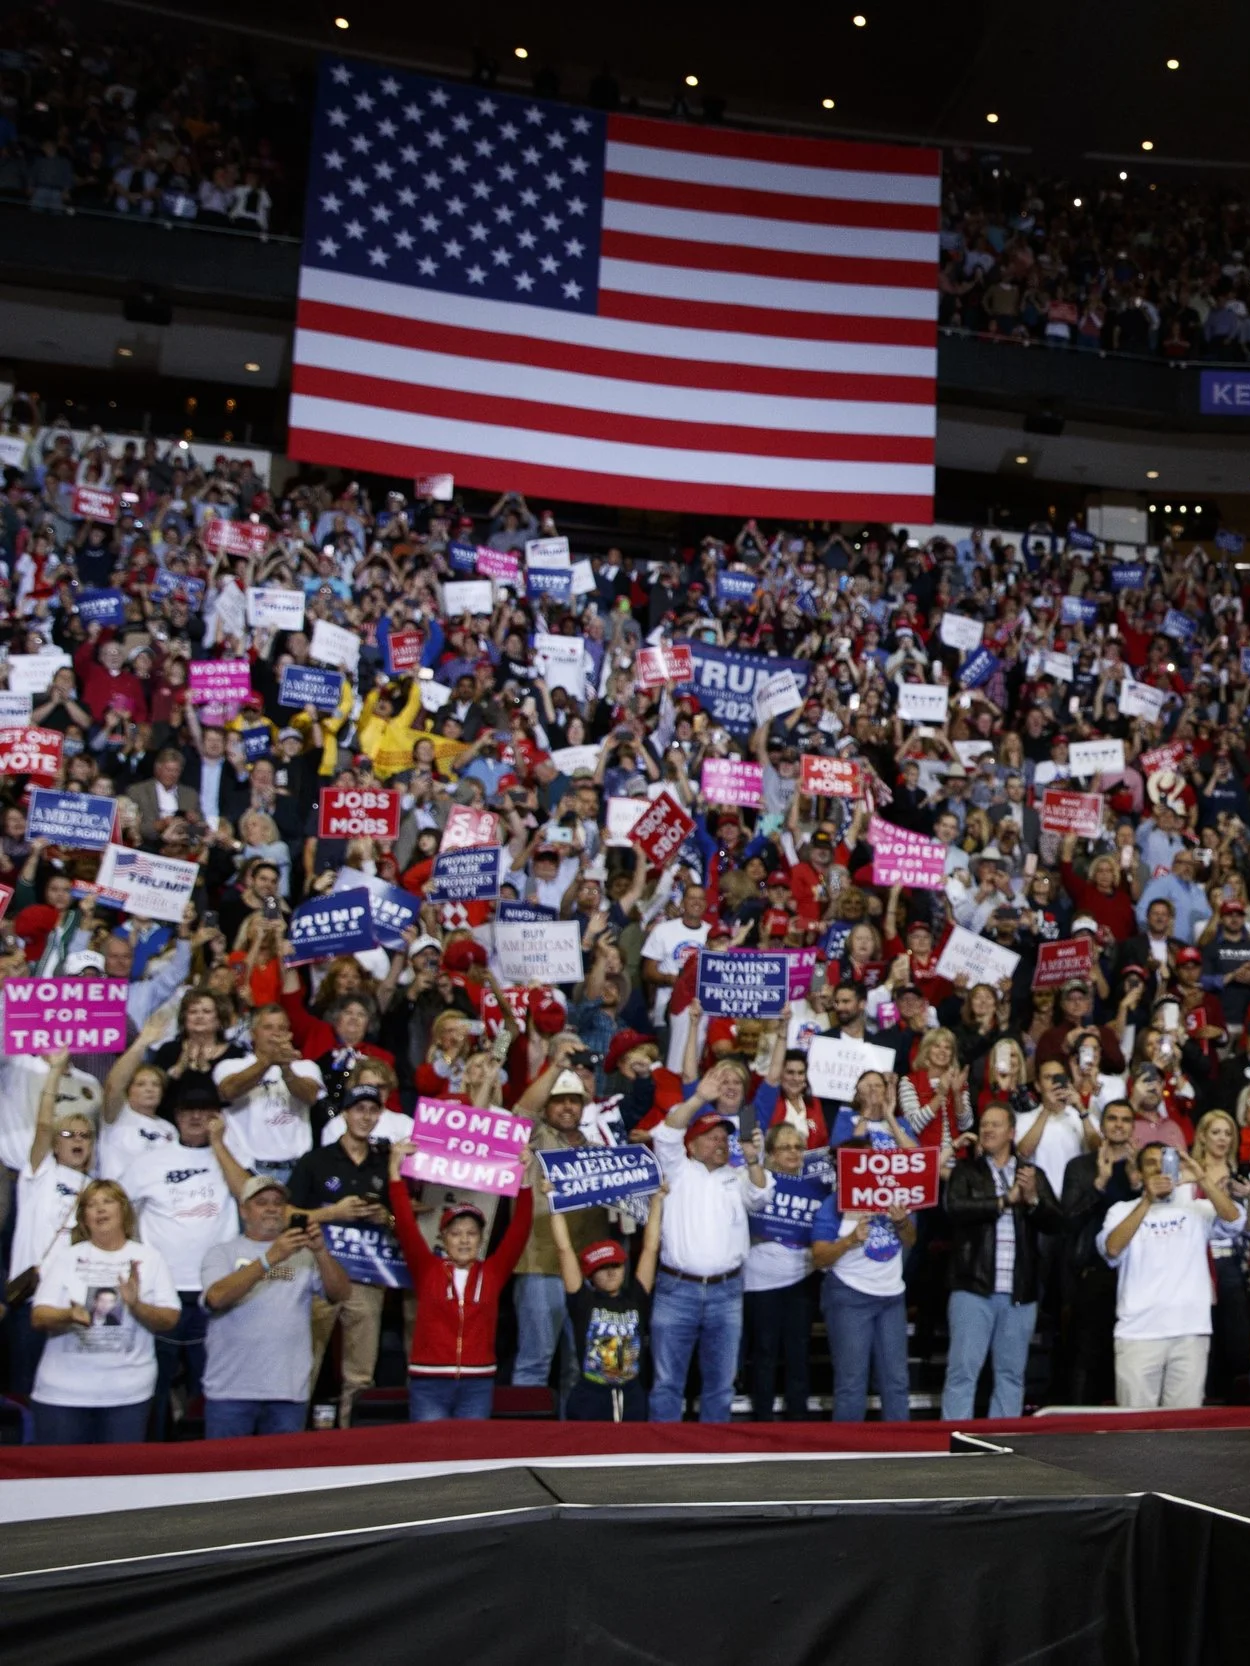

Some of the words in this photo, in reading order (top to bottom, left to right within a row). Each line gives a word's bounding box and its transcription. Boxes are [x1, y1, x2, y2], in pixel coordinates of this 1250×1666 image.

[529, 573, 570, 585] TRUMP
[190, 662, 250, 676] WOMEN
[713, 699, 757, 722] 202
[26, 730, 61, 747] OUT
[0, 752, 57, 772] VOTE
[704, 762, 763, 778] WOMEN
[809, 759, 853, 775] JOBS
[808, 778, 854, 793] MOBS
[332, 790, 390, 809] JOBS
[704, 787, 761, 802] TRUMP
[34, 807, 111, 830] AMERICA
[330, 817, 388, 834] MOBS
[635, 799, 672, 840] MOBS
[30, 823, 73, 839] STRONG
[75, 827, 110, 841] AGAIN
[652, 818, 686, 859] JOBS
[438, 852, 494, 867] PROMISES
[876, 843, 946, 860] WOMEN
[896, 858, 923, 868] FOR
[128, 872, 191, 893] TRUMP
[435, 875, 493, 888] PROMISES
[879, 868, 942, 885] TRUMP
[369, 895, 413, 919] UMP
[522, 929, 546, 938] BUY
[502, 939, 575, 952] AMERICAN
[706, 958, 781, 975] PROMISES
[1041, 956, 1092, 971] AMERICA
[720, 972, 766, 987] MADE
[6, 982, 129, 1002] WOMEN
[704, 985, 780, 1002] PROMISES
[43, 1007, 88, 1022] FOR
[720, 1000, 762, 1013] KEPT
[10, 1027, 121, 1049] TRUMP
[417, 1103, 532, 1144] WOMEN
[446, 1137, 490, 1158] FOR
[413, 1152, 516, 1188] TRUMP
[549, 1153, 655, 1183] AMERICA
[853, 1153, 927, 1175] JOBS
[562, 1177, 600, 1197] SAFE
[602, 1167, 649, 1188] AGAIN
[876, 1175, 900, 1187] VS.
[775, 1192, 822, 1209] UMP
[852, 1186, 925, 1207] MOBS
[765, 1204, 814, 1220] ENCE
[328, 1224, 380, 1246] TRU
[333, 1240, 393, 1258] PENC
